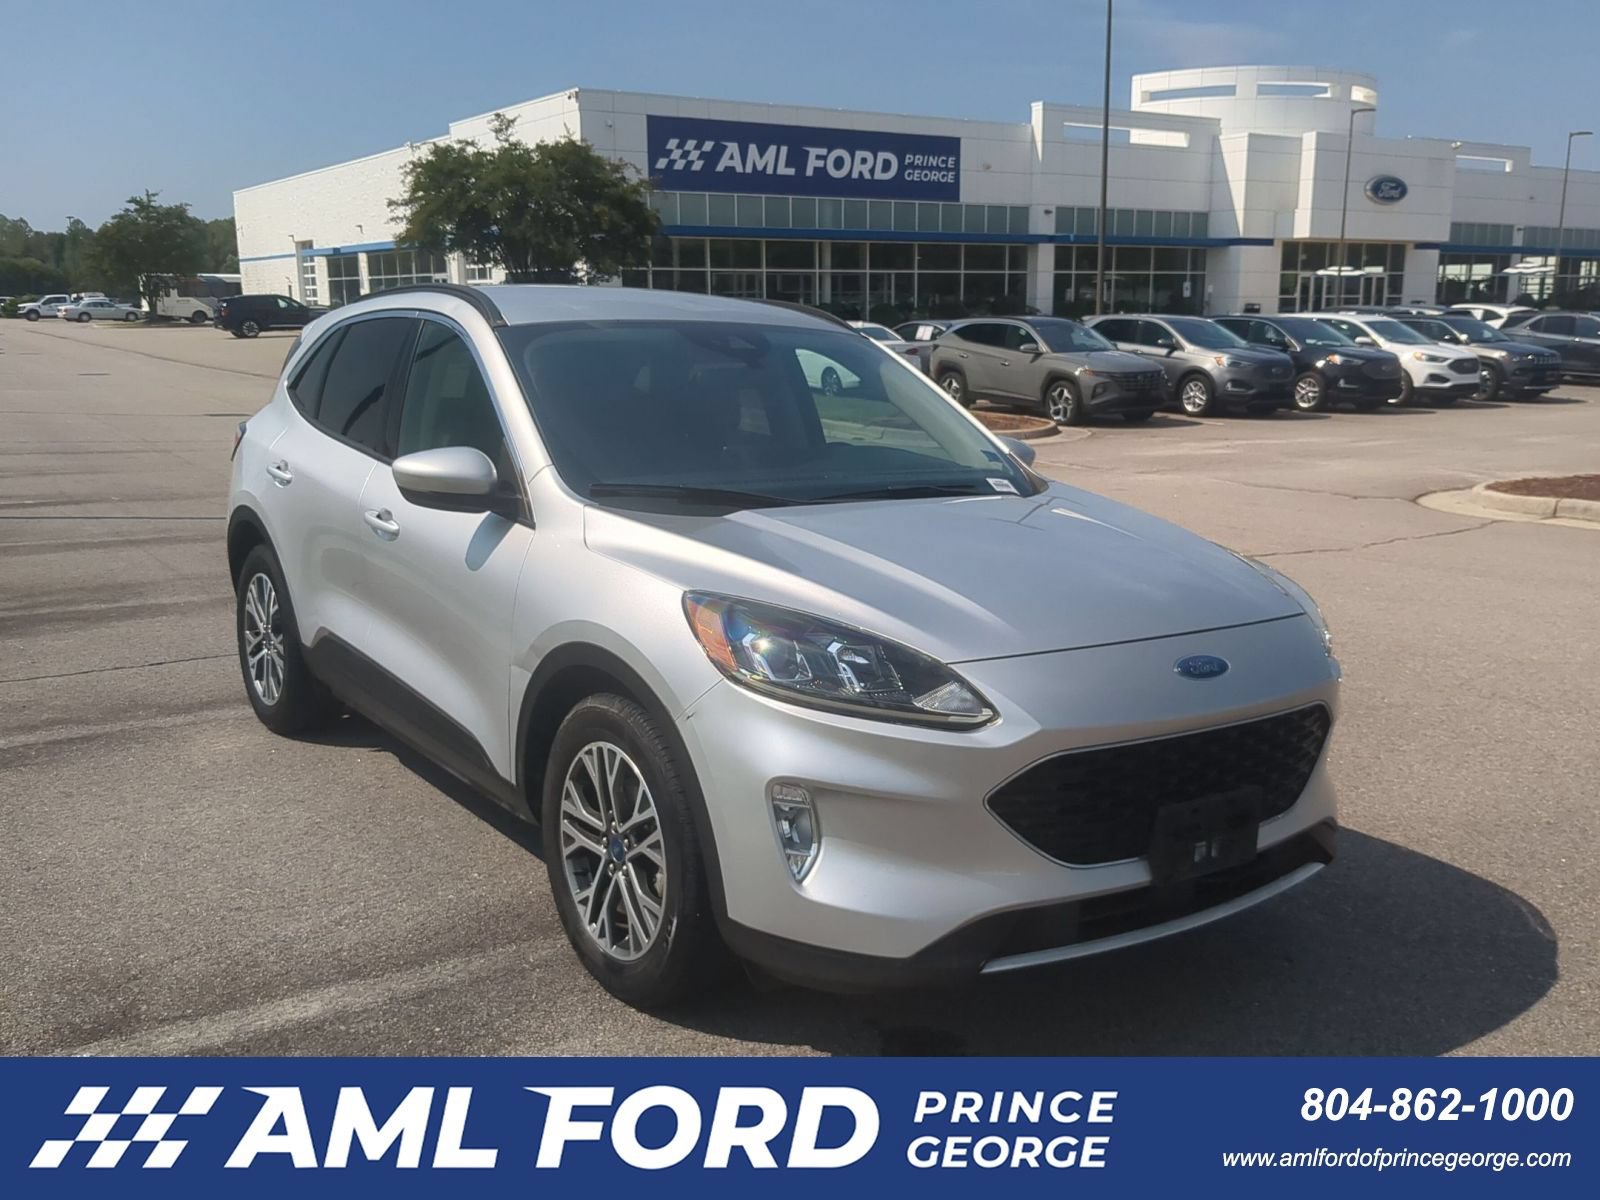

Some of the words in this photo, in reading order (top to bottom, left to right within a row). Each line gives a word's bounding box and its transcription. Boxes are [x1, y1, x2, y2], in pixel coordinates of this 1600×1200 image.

[715, 141, 796, 176] AML
[802, 147, 899, 181] FORD
[904, 153, 957, 169] PRINCE
[903, 169, 956, 184] GEORGE
[1377, 181, 1402, 198] Ford
